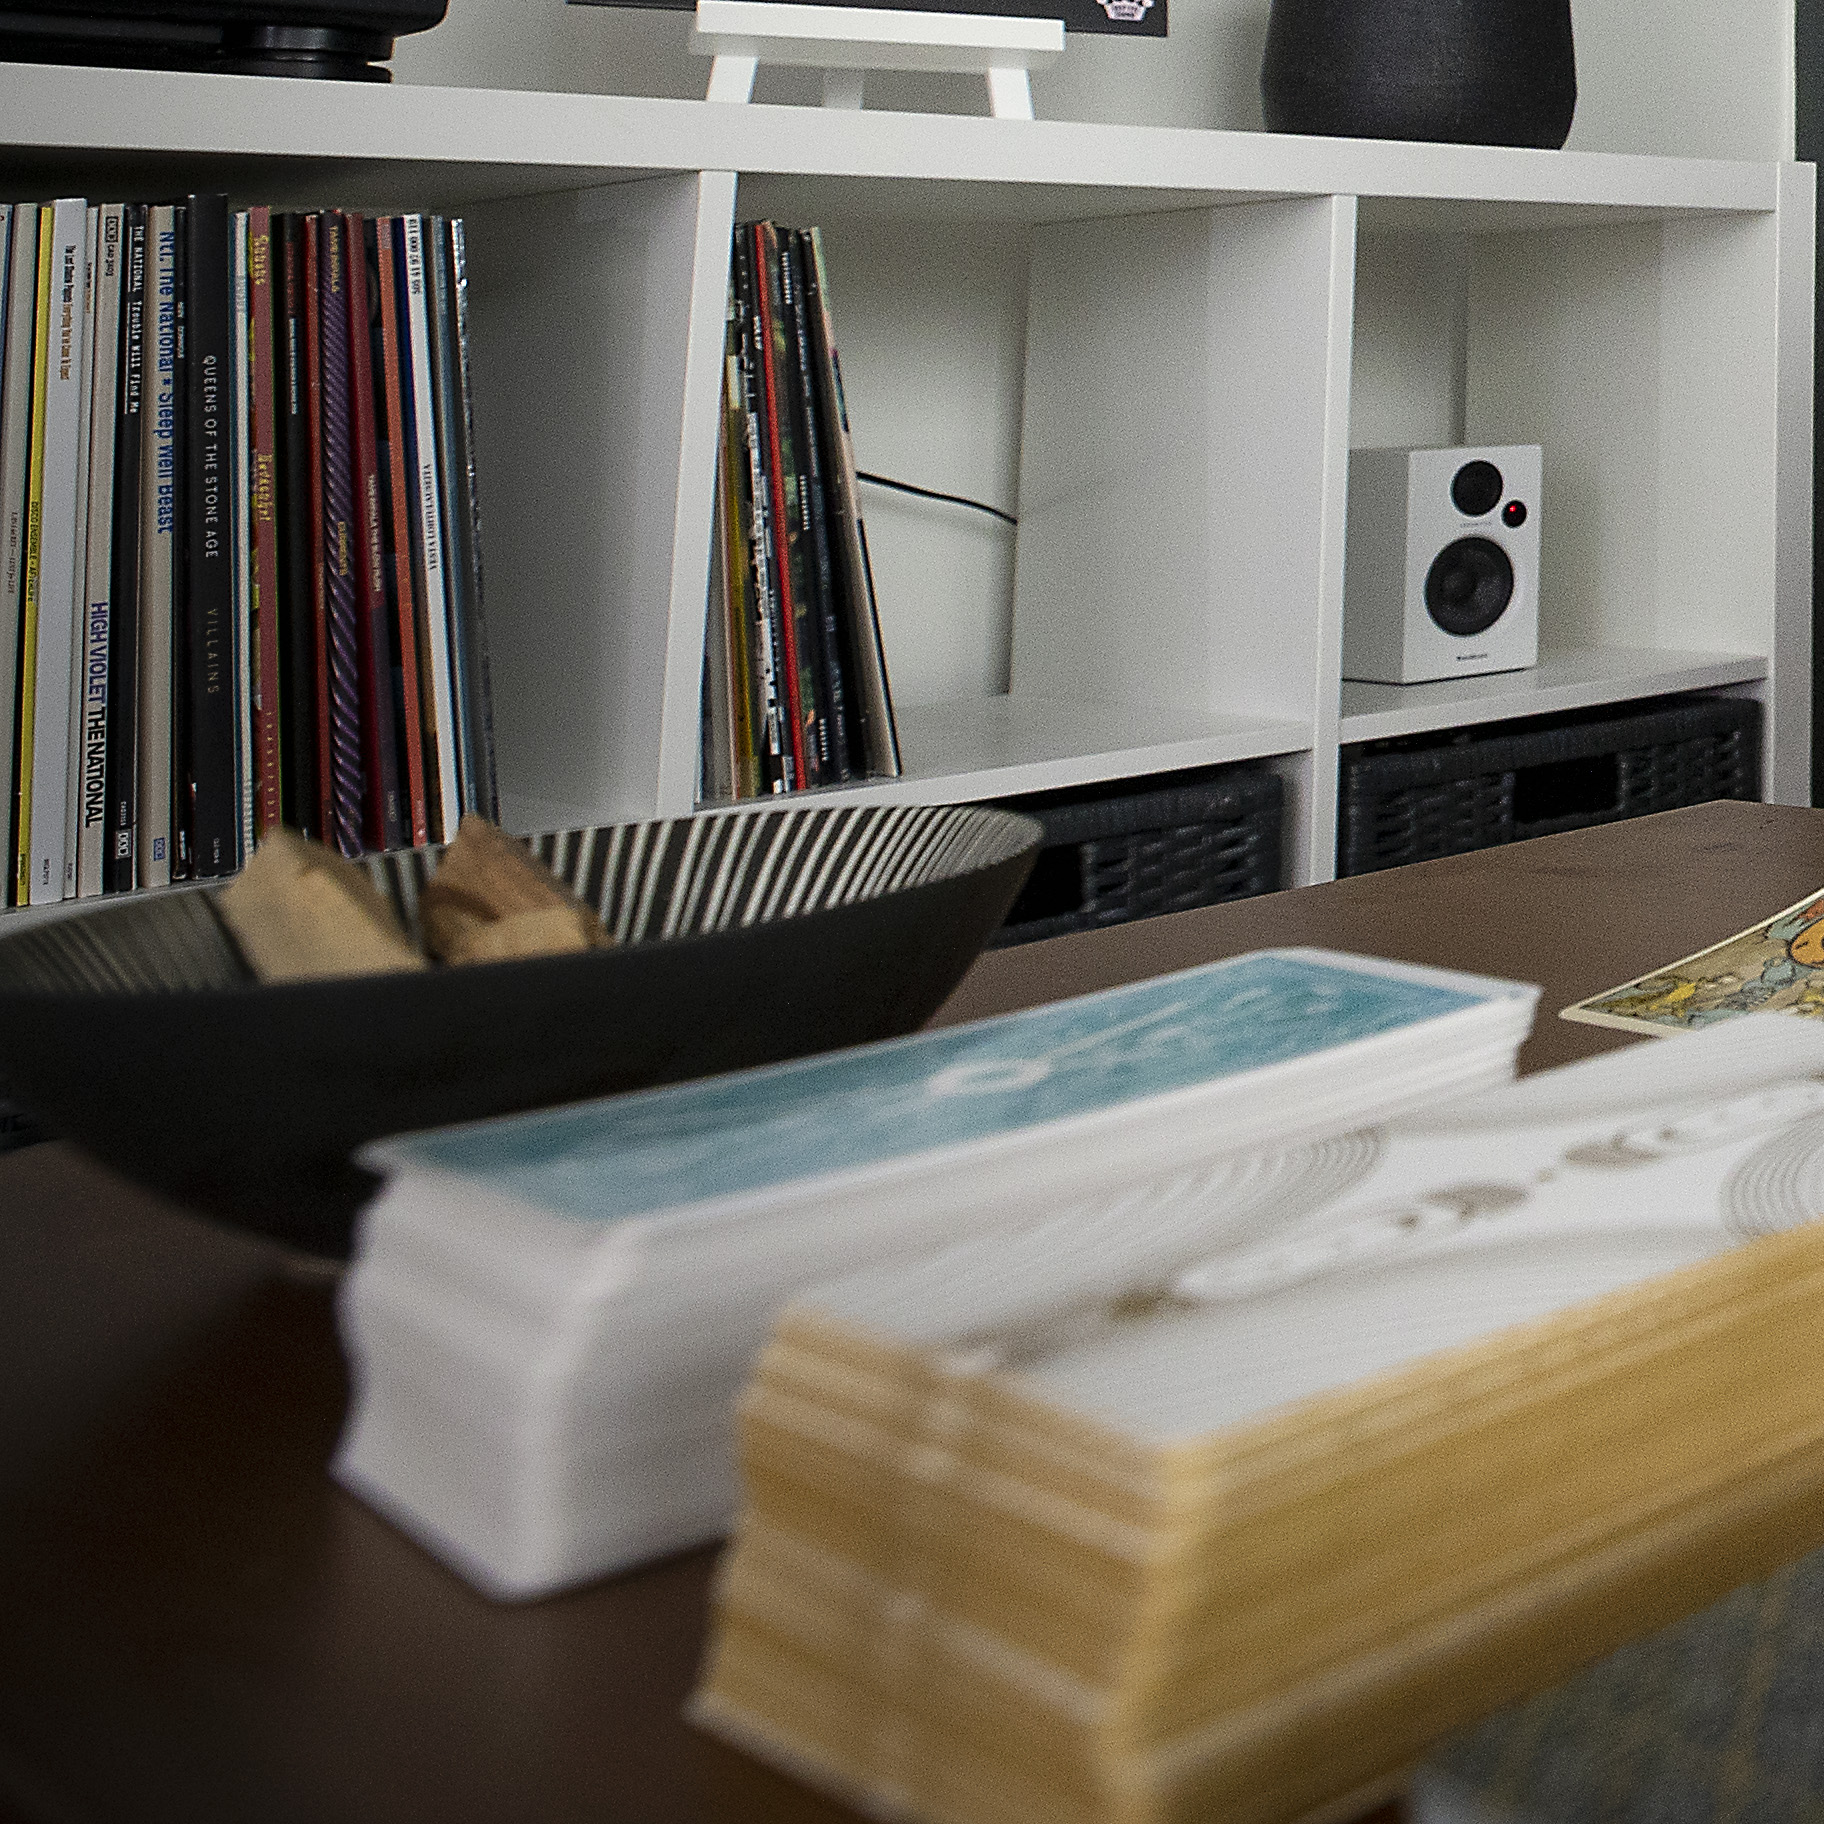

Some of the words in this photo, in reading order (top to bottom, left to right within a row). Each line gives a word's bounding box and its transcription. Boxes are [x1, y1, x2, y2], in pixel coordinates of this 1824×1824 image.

[134, 226, 144, 242] THE
[132, 247, 144, 293] NATIONAL
[159, 267, 175, 296] The
[131, 300, 143, 340] Trouble
[158, 302, 175, 372] National
[130, 345, 142, 368] Will
[129, 374, 141, 396] Find
[203, 355, 217, 412] QUEENS
[129, 402, 140, 414] Me
[153, 392, 174, 439] Sleep
[204, 419, 217, 437] OF
[158, 445, 174, 479] Well
[204, 444, 218, 470] THE
[30, 501, 39, 522] DISCO
[157, 485, 174, 534] Beast
[204, 476, 218, 524] STONE
[29, 524, 39, 559] ENSEMBLE
[204, 530, 219, 558] AGE
[90, 602, 109, 643] HIGH
[206, 608, 219, 694] VILLAINS
[88, 646, 107, 704] VIOLET
[88, 707, 106, 740] THE
[85, 743, 105, 828] NATIONAL
